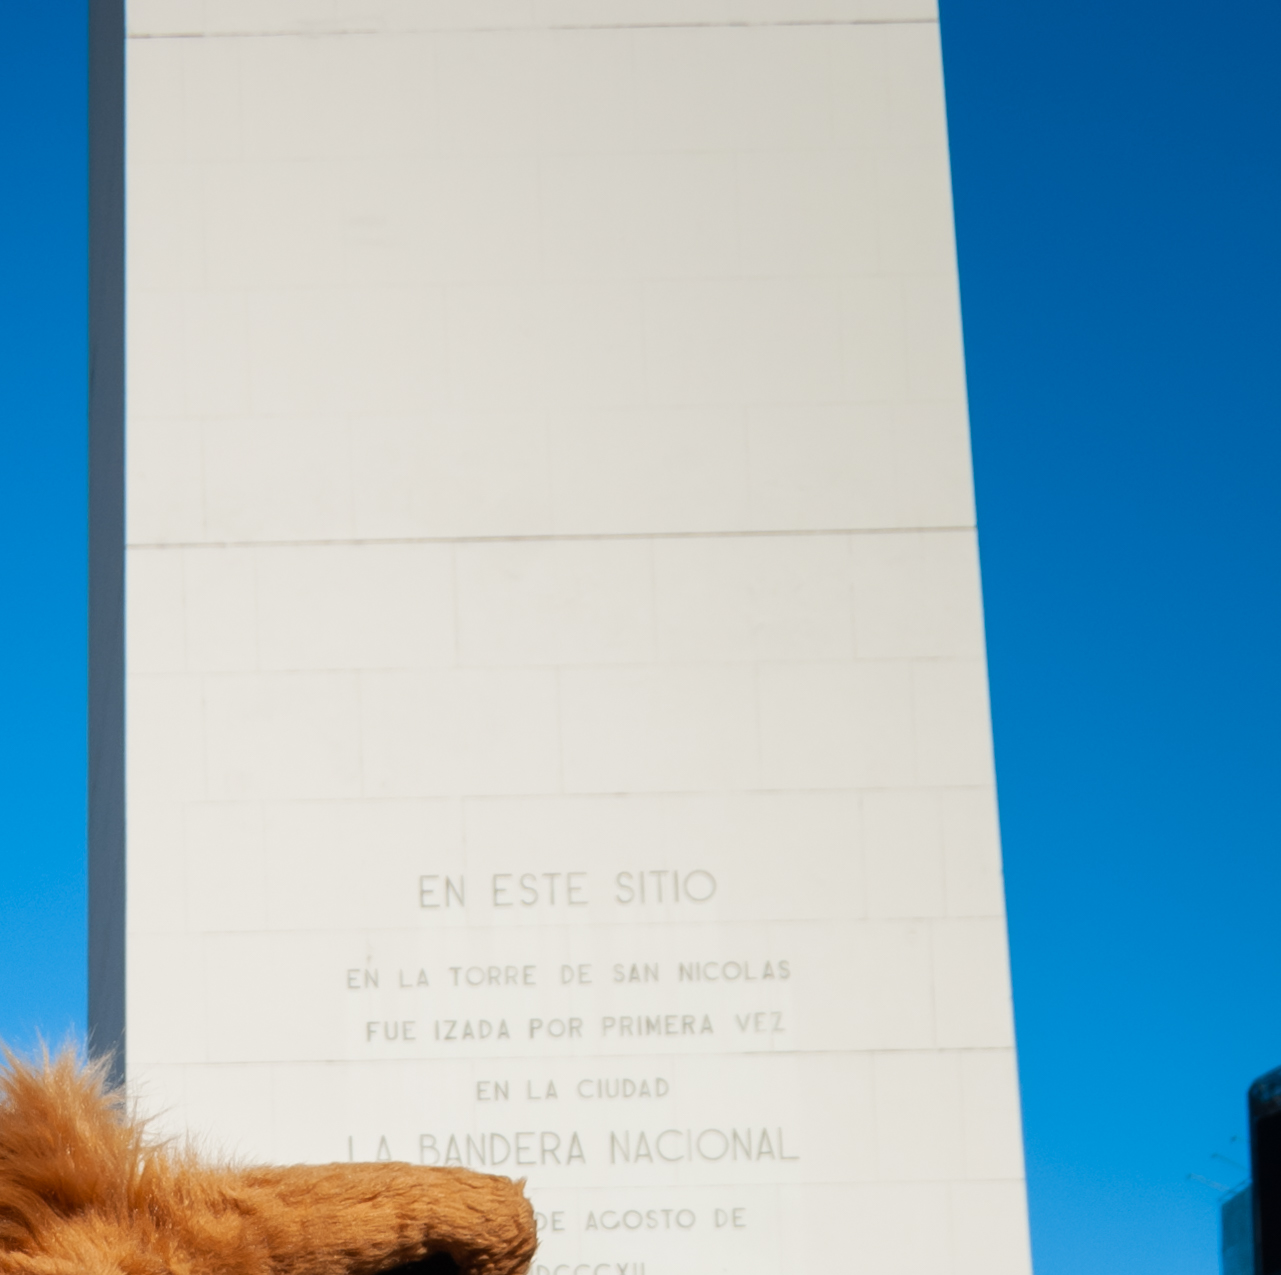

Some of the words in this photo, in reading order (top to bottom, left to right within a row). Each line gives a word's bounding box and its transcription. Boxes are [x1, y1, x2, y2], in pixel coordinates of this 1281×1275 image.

[418, 875, 465, 909] EN
[492, 872, 588, 908] ESTE
[615, 869, 717, 905] SITIO
[346, 968, 379, 990] EN
[399, 968, 429, 989] LA
[448, 965, 536, 987] TORRE
[560, 964, 592, 985] DE
[613, 963, 659, 983] SAN
[678, 960, 791, 982] NICOLAS
[366, 1020, 416, 1042] FUE
[434, 1019, 510, 1042] IZADA
[528, 1017, 583, 1040] POR
[601, 1014, 714, 1036] PRIMERA
[735, 1011, 784, 1032] VEZ
[475, 1080, 509, 1102] EN
[526, 1080, 558, 1101] LA
[577, 1077, 669, 1099] CIUDAD
[419, 1131, 586, 1168] BANDERA
[609, 1127, 800, 1165] NACIONAL
[535, 1210, 566, 1232] DE
[585, 1209, 696, 1231] AGOSTO
[714, 1207, 746, 1229] DE
